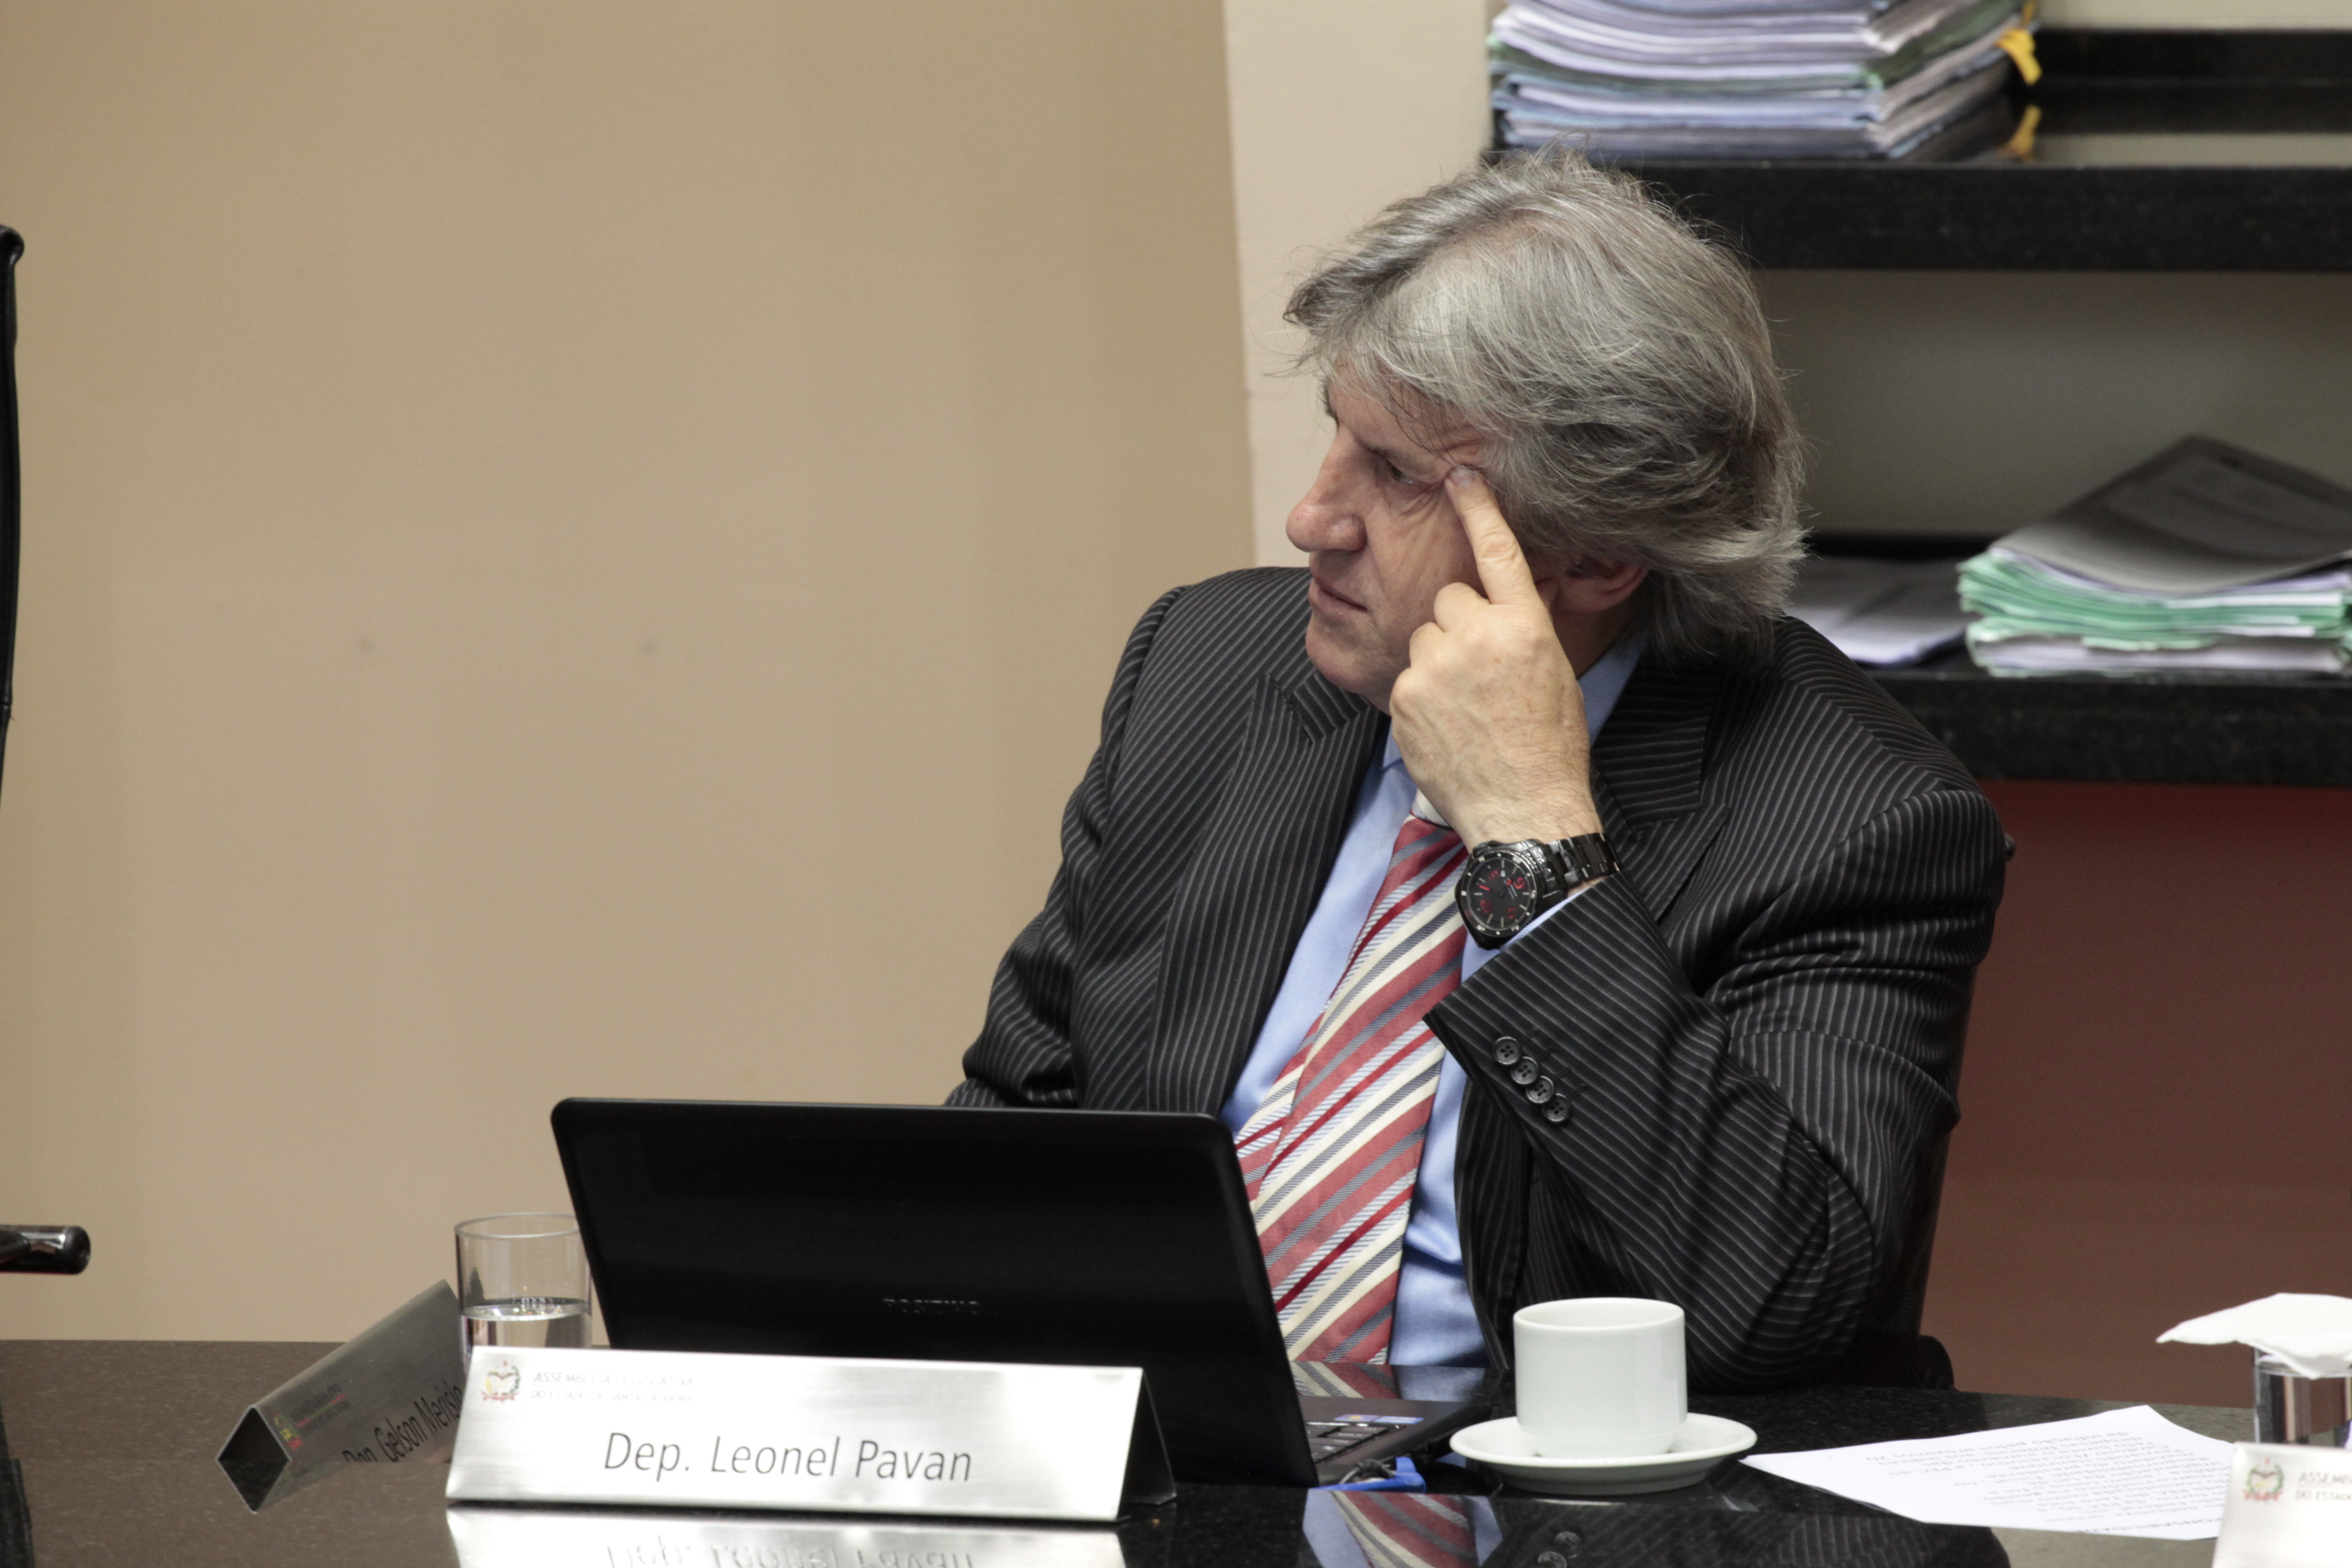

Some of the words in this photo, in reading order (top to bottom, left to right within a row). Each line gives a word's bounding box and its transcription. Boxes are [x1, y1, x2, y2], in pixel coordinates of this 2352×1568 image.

[374, 1416, 427, 1462] Gelson
[604, 1432, 689, 1482] Dep.
[711, 1436, 841, 1477] Leonel
[855, 1440, 972, 1482] Pavan
